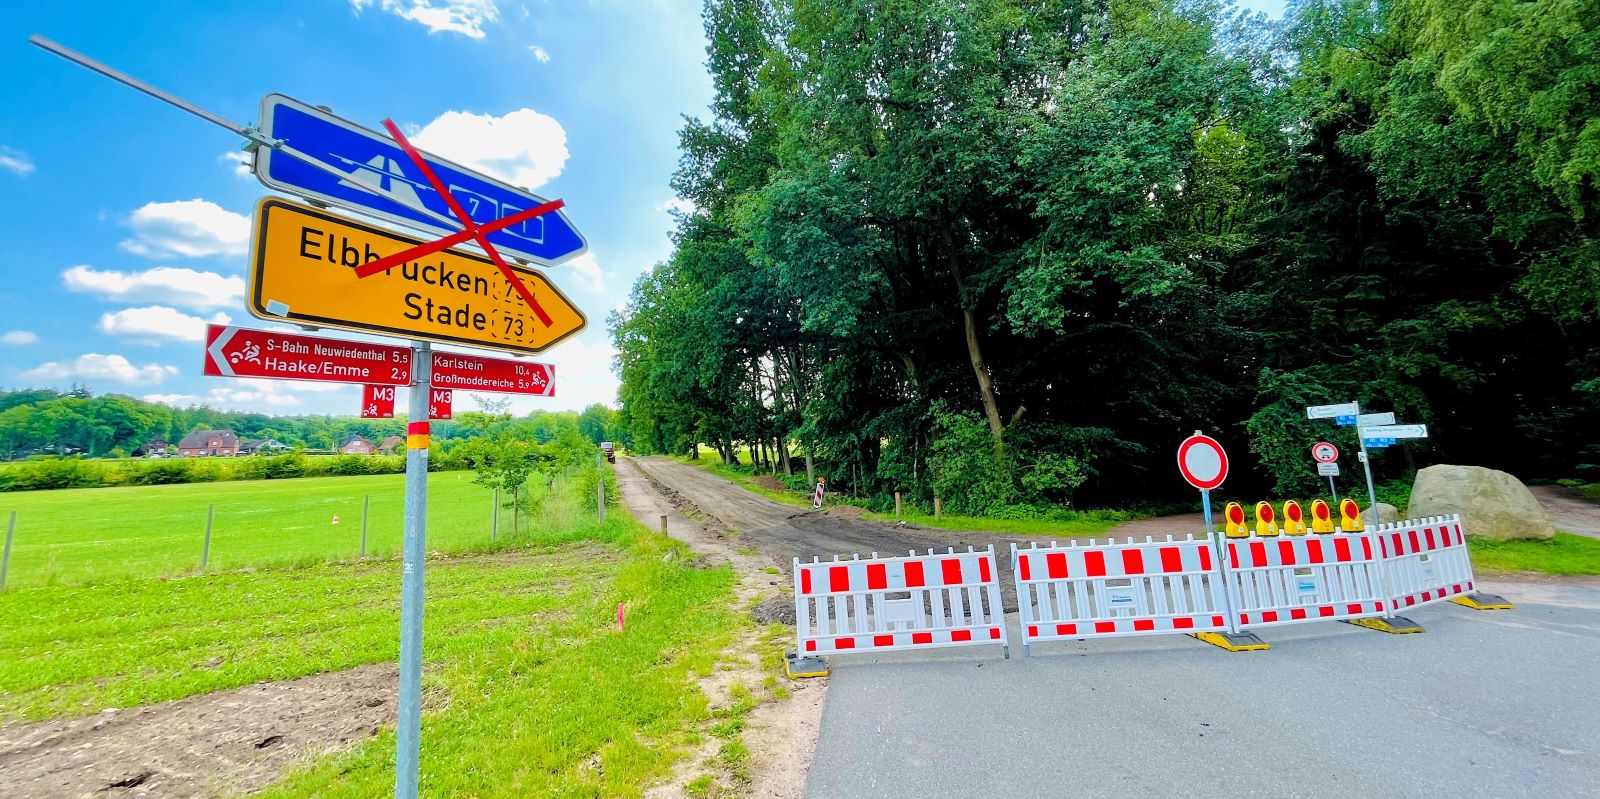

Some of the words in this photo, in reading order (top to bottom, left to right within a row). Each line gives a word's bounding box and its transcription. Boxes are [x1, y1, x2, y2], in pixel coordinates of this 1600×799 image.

[469, 198, 480, 217] 7
[402, 292, 487, 331] Stade
[504, 316, 524, 337] 73
[266, 338, 310, 355] S-Bahn
[314, 343, 387, 361] Neuwiedenthal
[392, 350, 408, 364] 5,5
[264, 356, 371, 377] Haake/Emme
[390, 367, 408, 380] 2,9
[433, 355, 484, 372] Karlstein
[514, 364, 530, 376] 10,4
[433, 372, 515, 388] Großmoddereiche
[517, 378, 530, 389] 5,9
[373, 386, 394, 402] M3
[433, 390, 451, 404] M3
